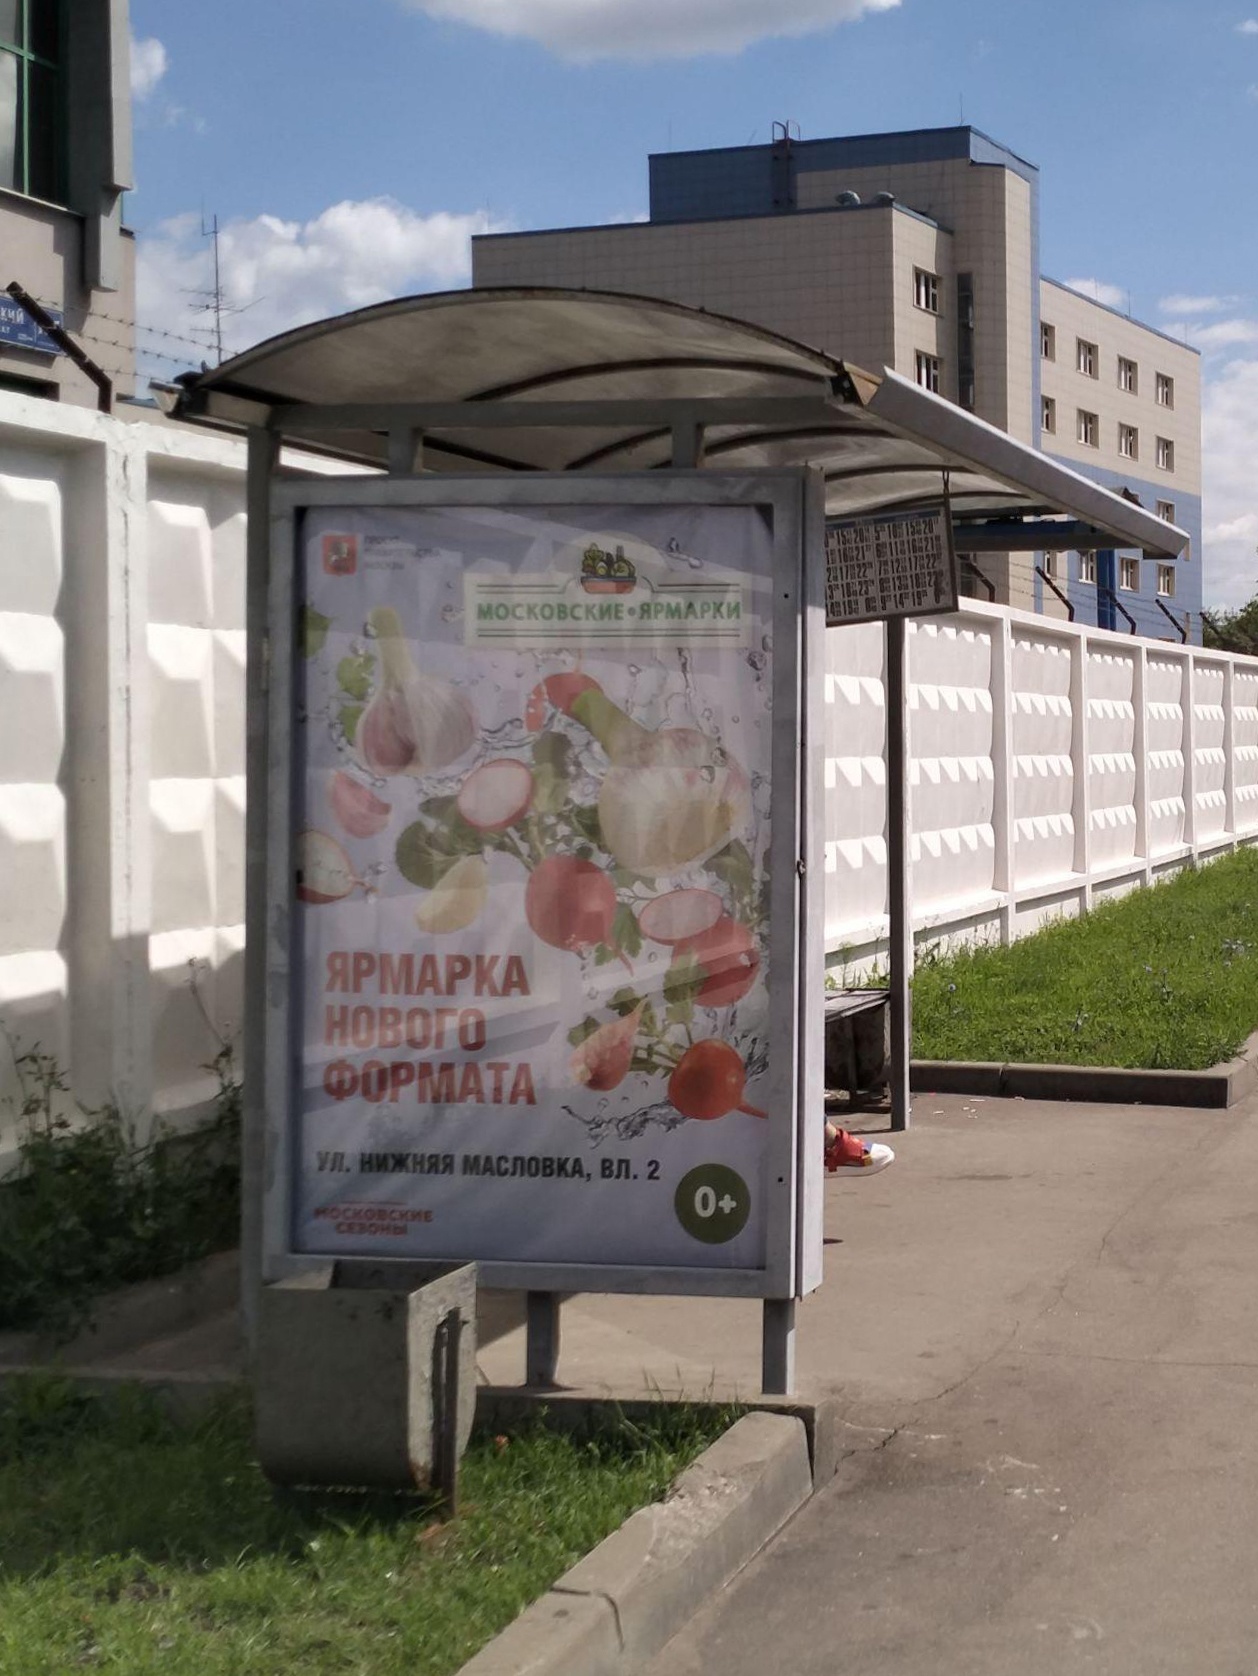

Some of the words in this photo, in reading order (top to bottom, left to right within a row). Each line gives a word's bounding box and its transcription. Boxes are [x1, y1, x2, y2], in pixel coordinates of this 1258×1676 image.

[477, 602, 624, 621] МОСКОВСКИЕ
[638, 601, 741, 620] ЯРМАРКИ
[325, 951, 531, 997] ЯРМАРКА
[324, 1005, 487, 1051] НОВОГО
[323, 1058, 537, 1106] ФОРМАТА
[317, 1152, 350, 1173] УЛ.
[360, 1153, 454, 1175] НИЖНЯЯ
[462, 1154, 592, 1182] МАСЛОВКА,
[601, 1158, 638, 1180] ВЛ.
[647, 1160, 661, 1181] 2
[694, 1186, 737, 1218] 0+
